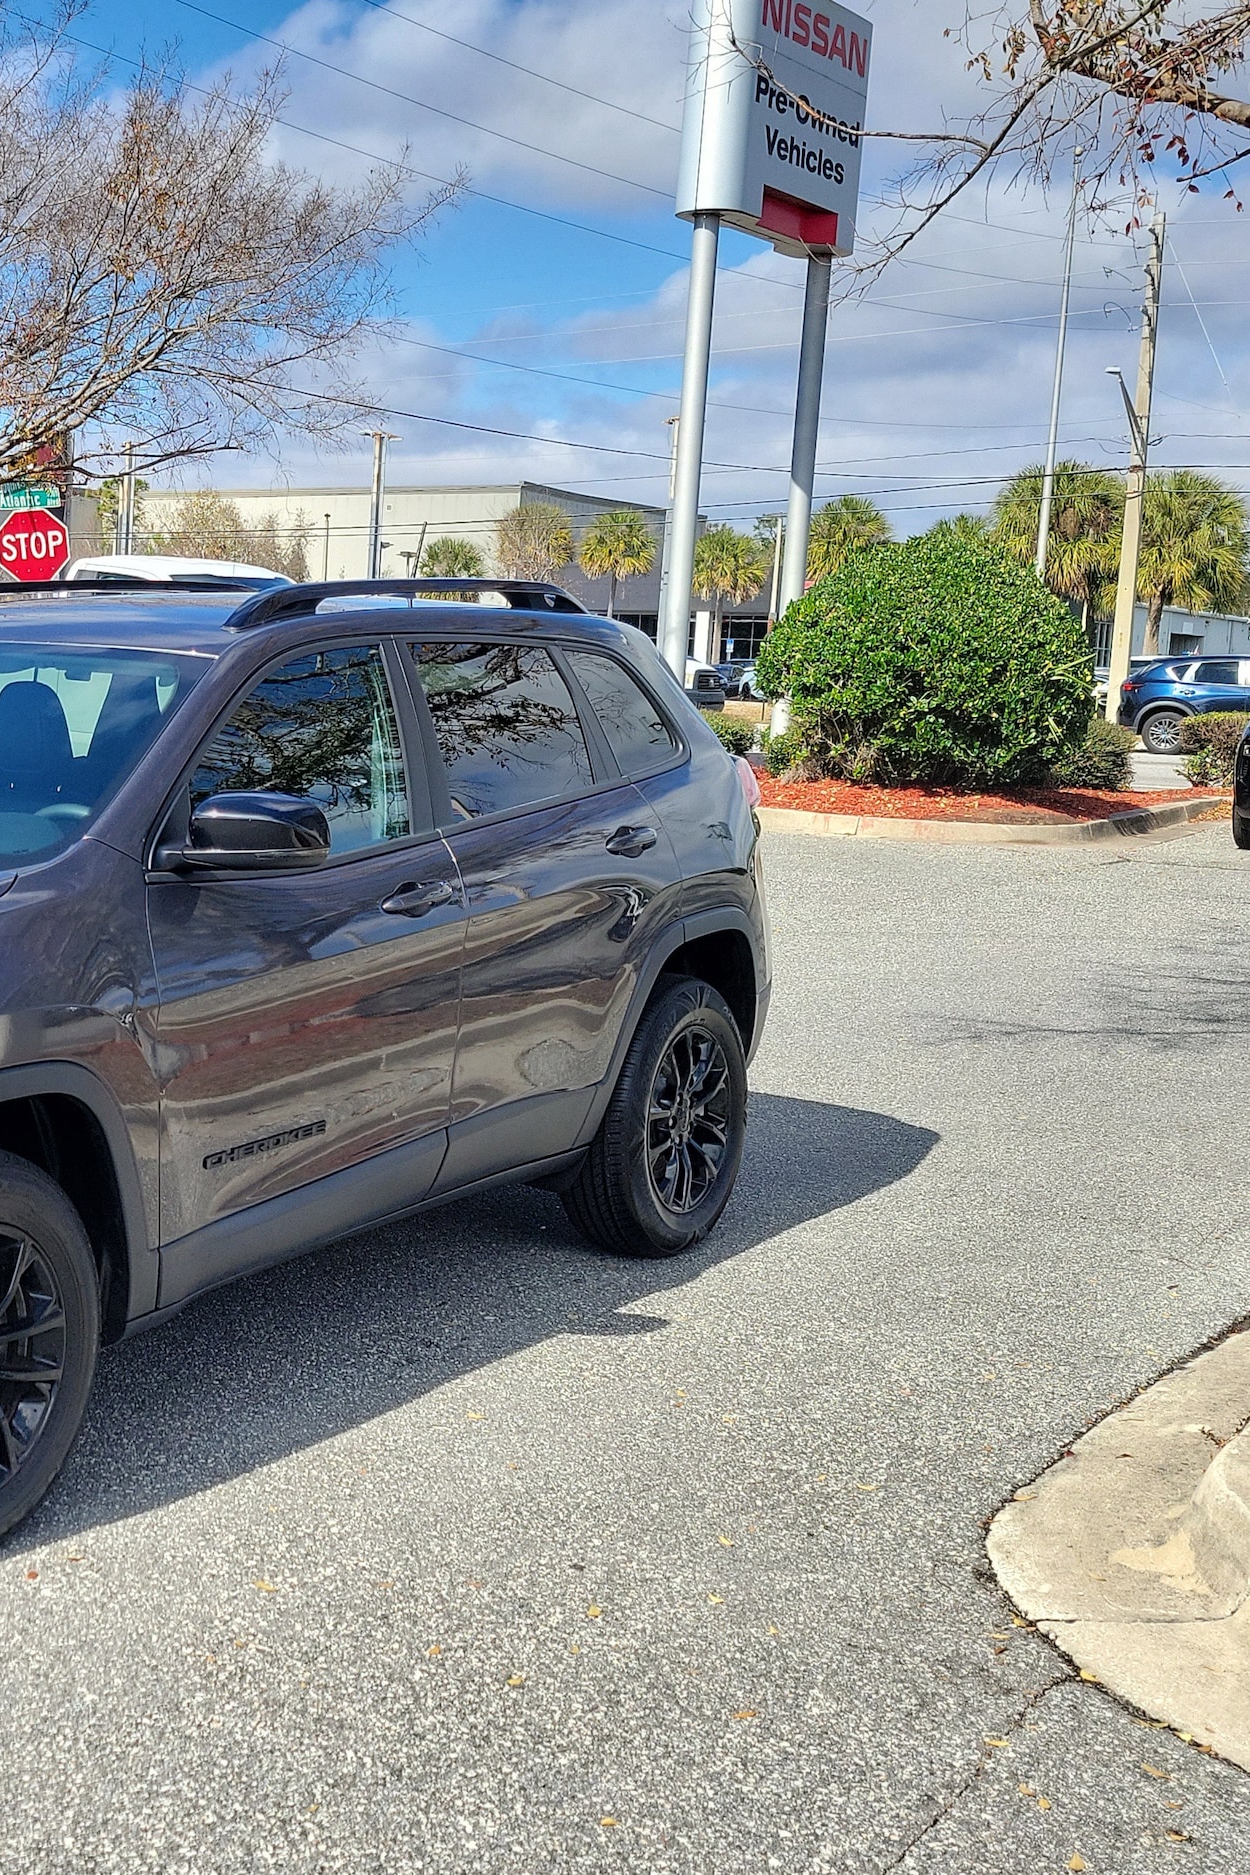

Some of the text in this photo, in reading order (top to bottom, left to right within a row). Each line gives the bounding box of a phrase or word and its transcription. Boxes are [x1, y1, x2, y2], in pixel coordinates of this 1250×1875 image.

[762, 0, 868, 78] NISSAN
[755, 74, 861, 148] Pre-Owned
[765, 124, 845, 184] Vehicles
[0, 493, 41, 508] Atlantic
[2, 530, 63, 561] STOP
[202, 1120, 326, 1169] CHEROKEE
